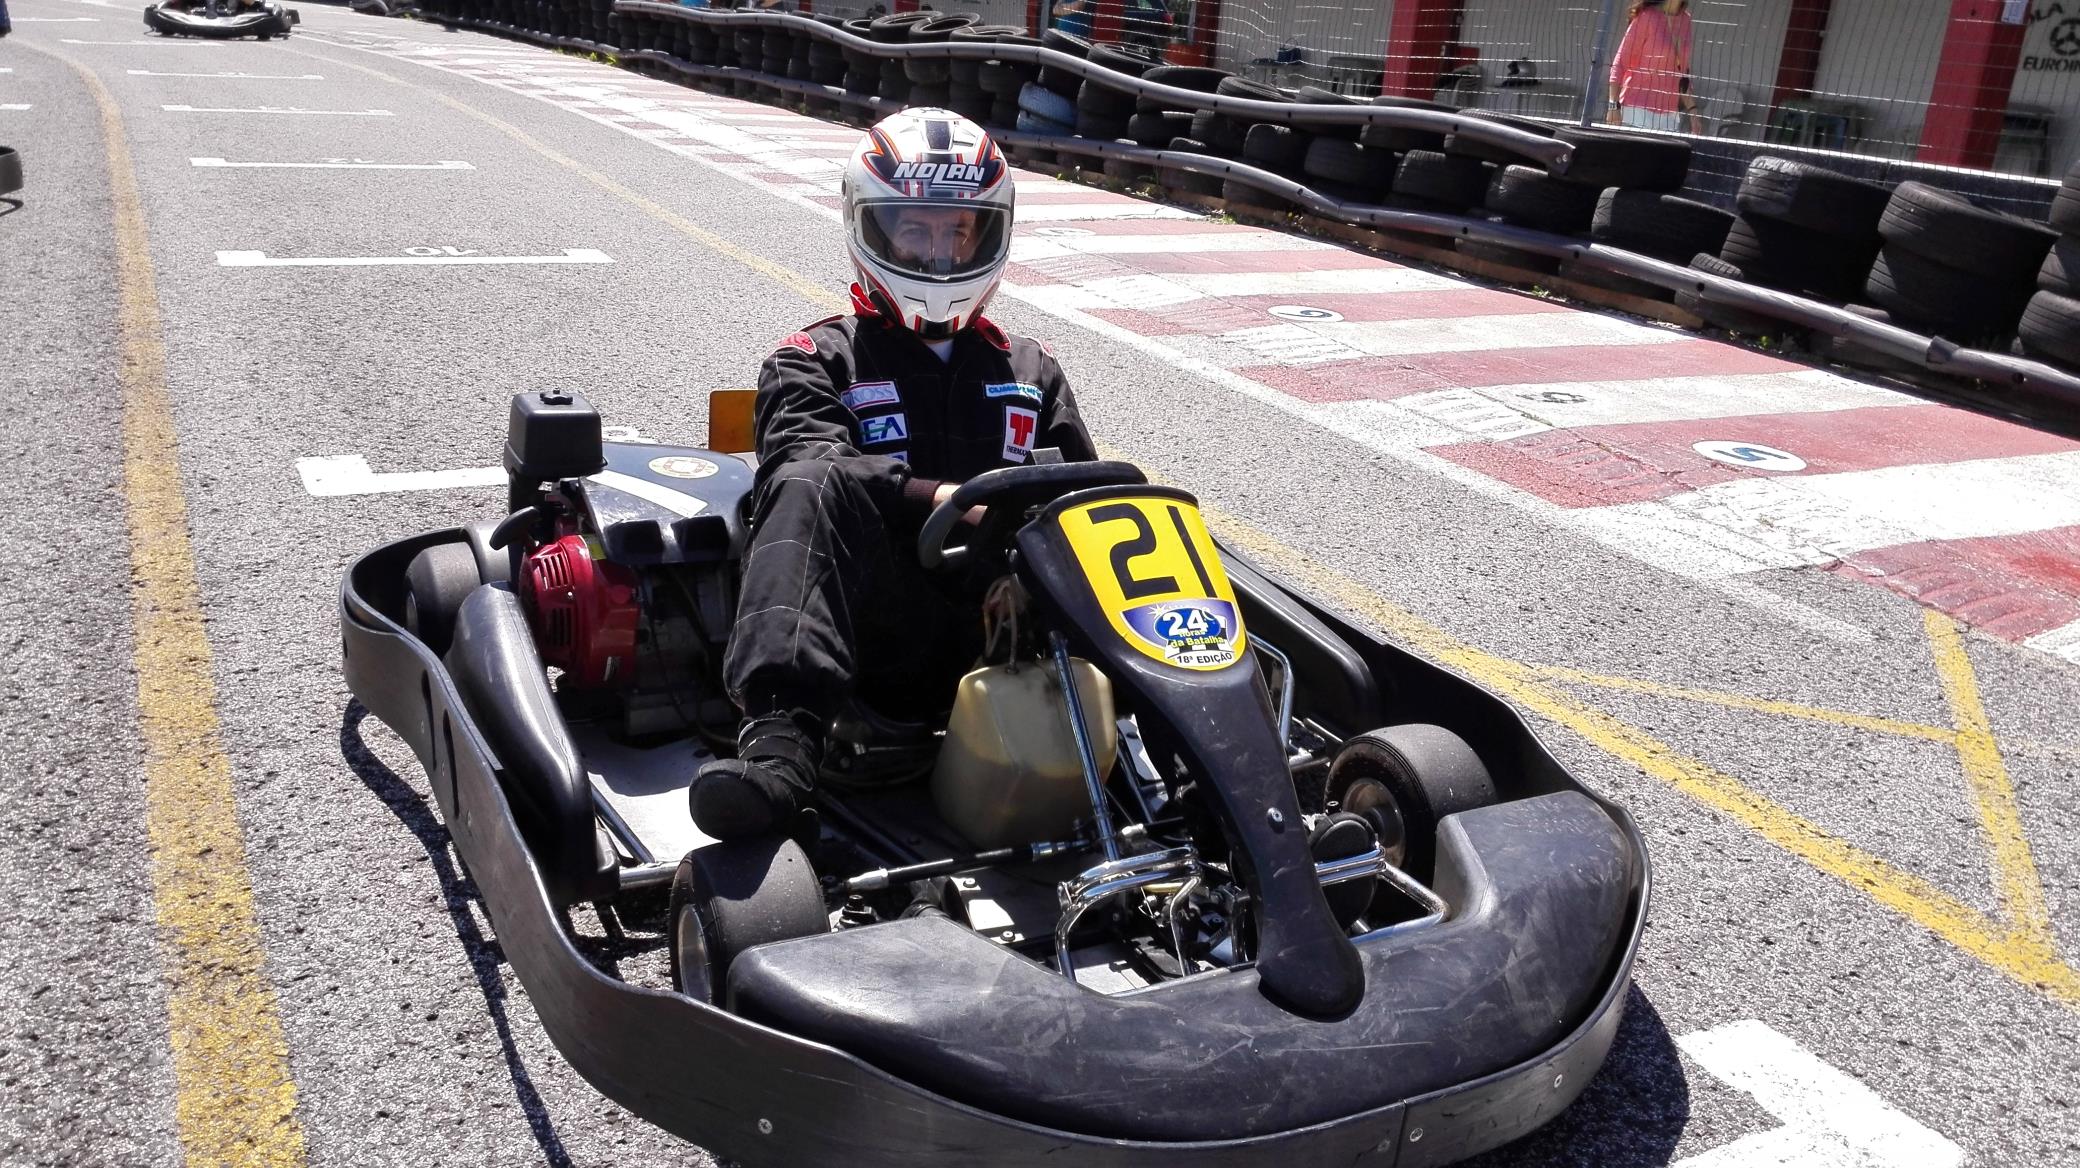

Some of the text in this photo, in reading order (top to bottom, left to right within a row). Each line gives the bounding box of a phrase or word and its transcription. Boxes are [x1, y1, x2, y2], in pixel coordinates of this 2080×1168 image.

[893, 162, 985, 184] NOLAN
[404, 246, 479, 256] 10
[1087, 502, 1218, 601] 21
[1163, 609, 1209, 636] 24
[1170, 639, 1185, 648] da
[1197, 652, 1233, 664] EDIÇÃO
